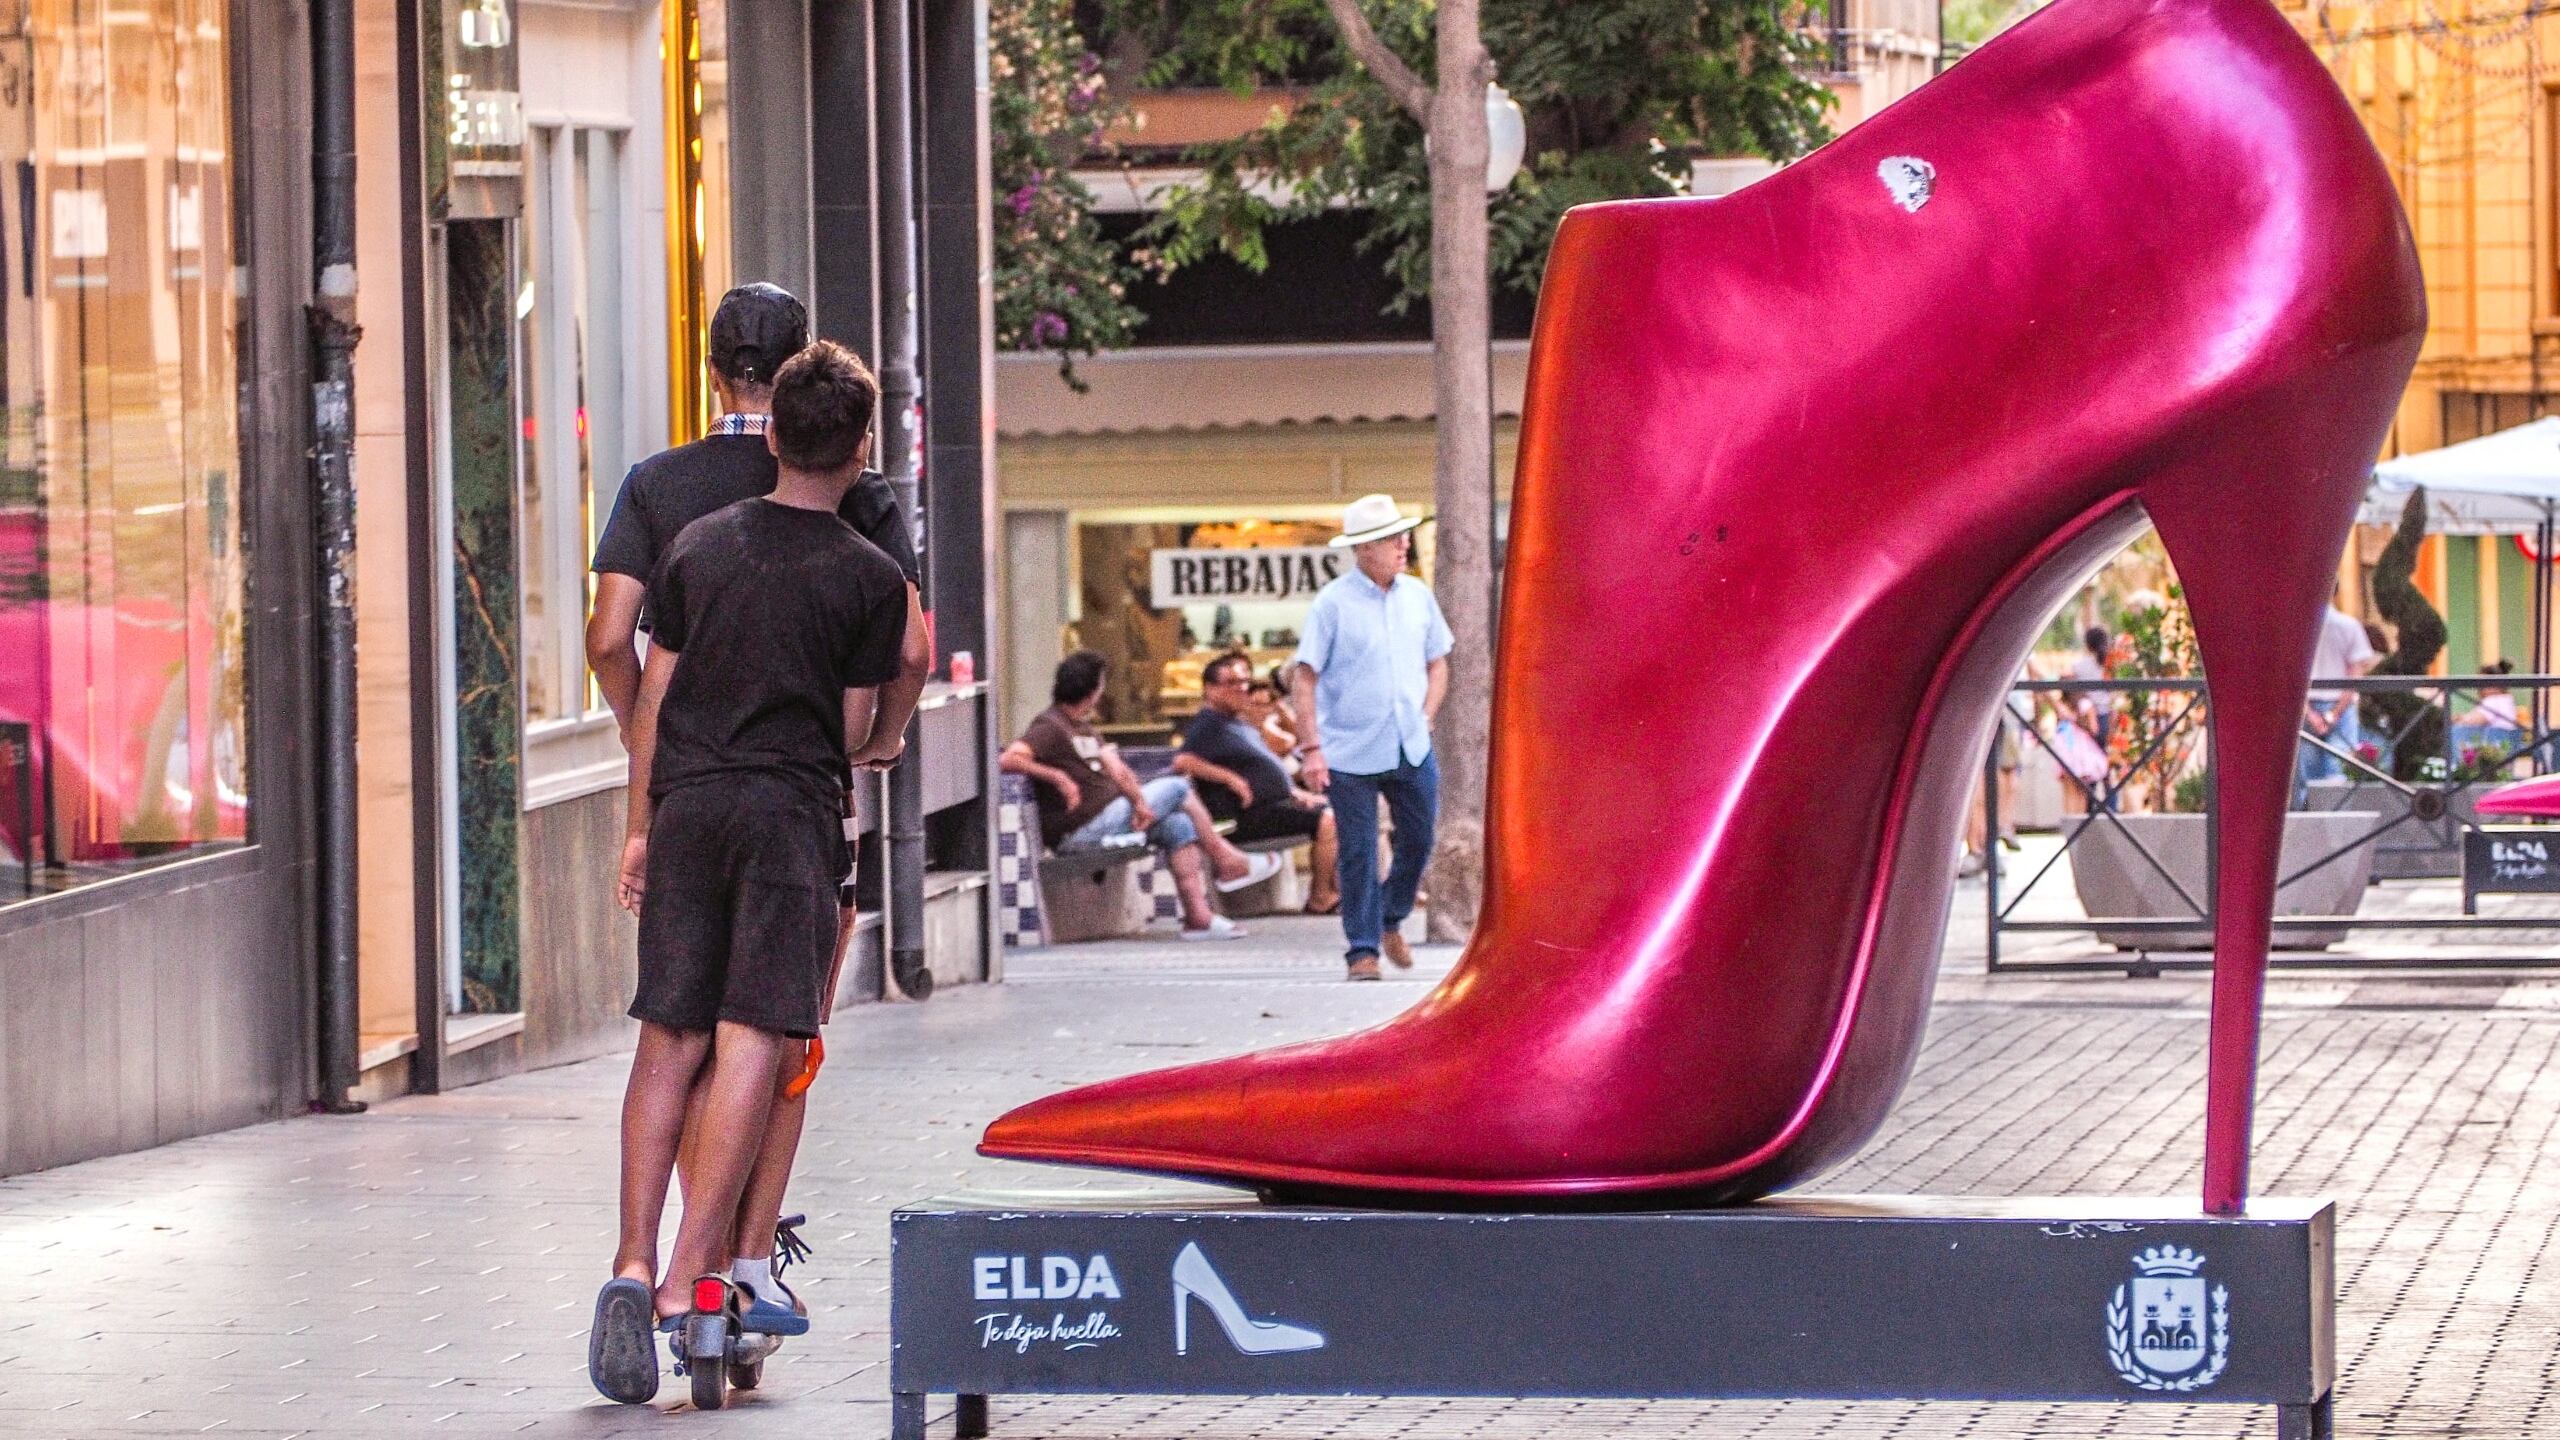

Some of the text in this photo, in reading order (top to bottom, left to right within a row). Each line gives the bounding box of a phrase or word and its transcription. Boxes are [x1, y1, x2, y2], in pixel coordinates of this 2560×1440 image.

[1170, 554, 1339, 598] REBAJAS
[974, 1255, 1121, 1299] ELDA
[974, 1312, 1010, 1349] Te
[1003, 1314, 1050, 1354] deja
